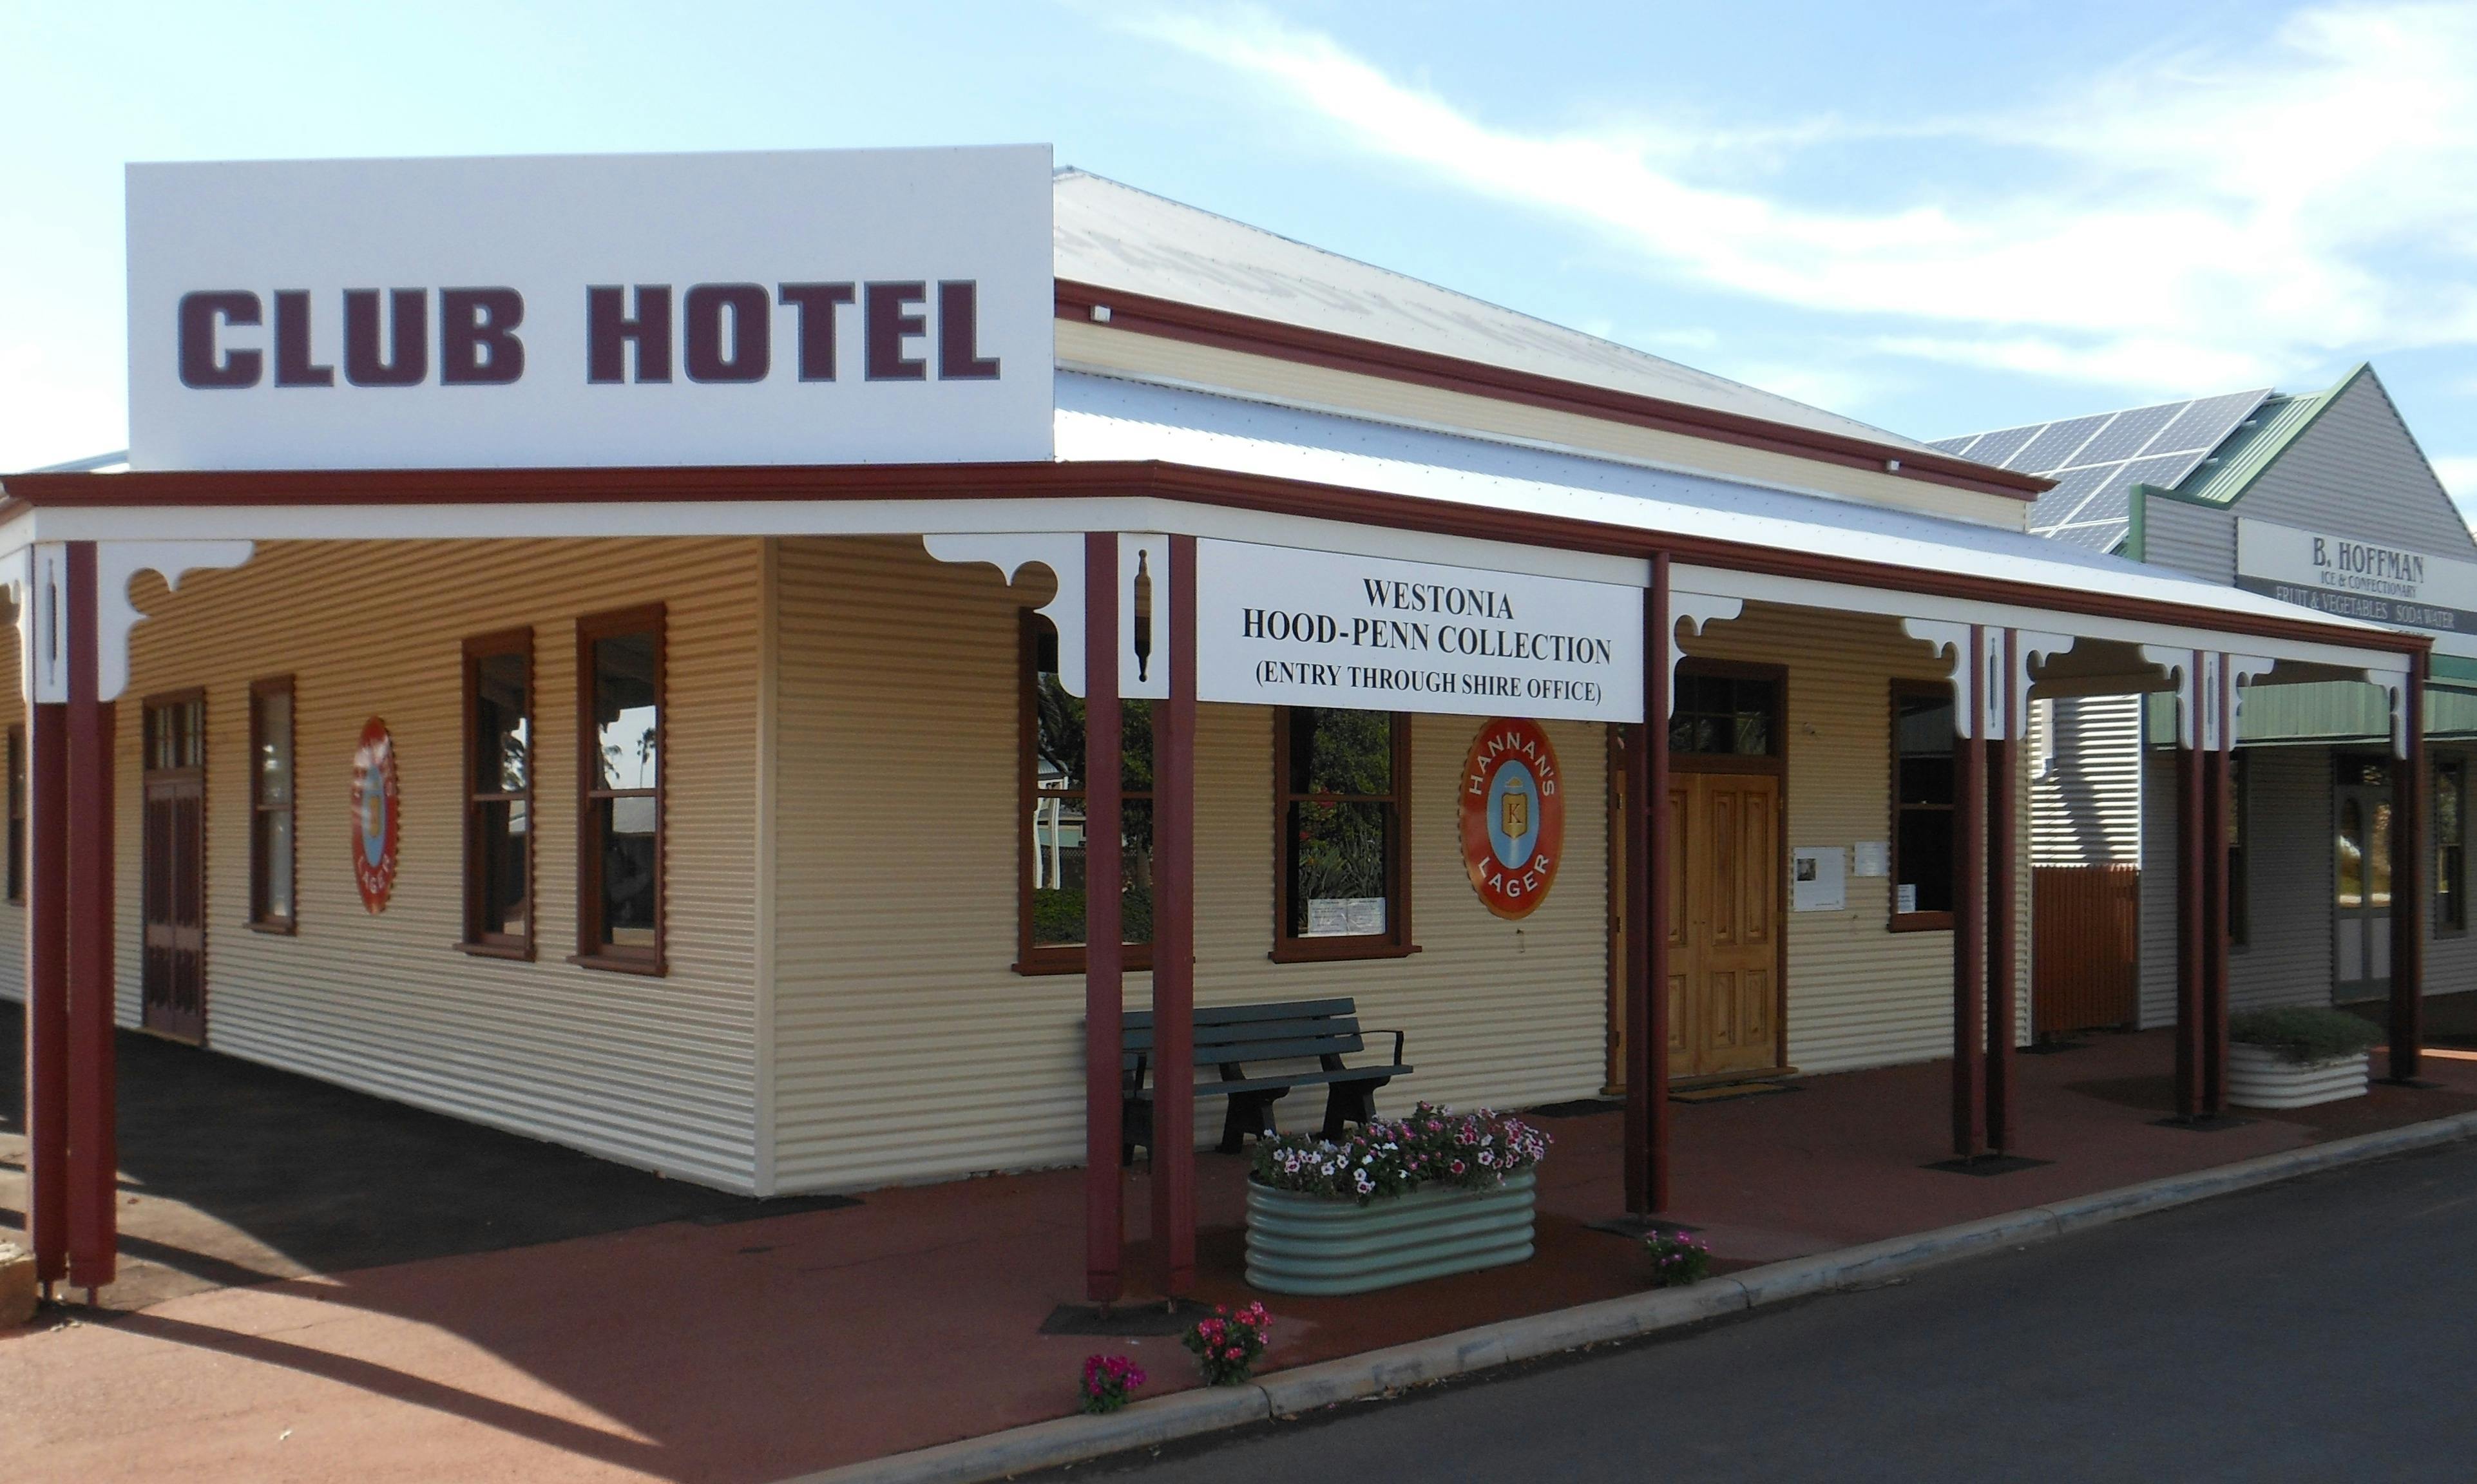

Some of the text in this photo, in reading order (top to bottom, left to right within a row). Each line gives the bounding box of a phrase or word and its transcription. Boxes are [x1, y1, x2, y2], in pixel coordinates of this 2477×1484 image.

[177, 279, 1001, 389] CLUB HOTEL
[2312, 537, 2424, 584] B. HOFFMAN
[2321, 571, 2335, 585] ICE
[2338, 575, 2346, 587] &
[1363, 578, 1515, 620] WESTONIA
[2276, 585, 2454, 629] FRUIT & VEGETABLES SODA WATER
[1241, 607, 1611, 665] HOOD-PENN COLLECTION
[1256, 660, 1602, 706] (ENTRY THROUGH SHIRE OFFICE)
[1469, 732, 1554, 797] HANNAN'S
[1507, 803, 1523, 824] K
[358, 853, 390, 894] LAGER
[1478, 853, 1549, 897] LAGER
